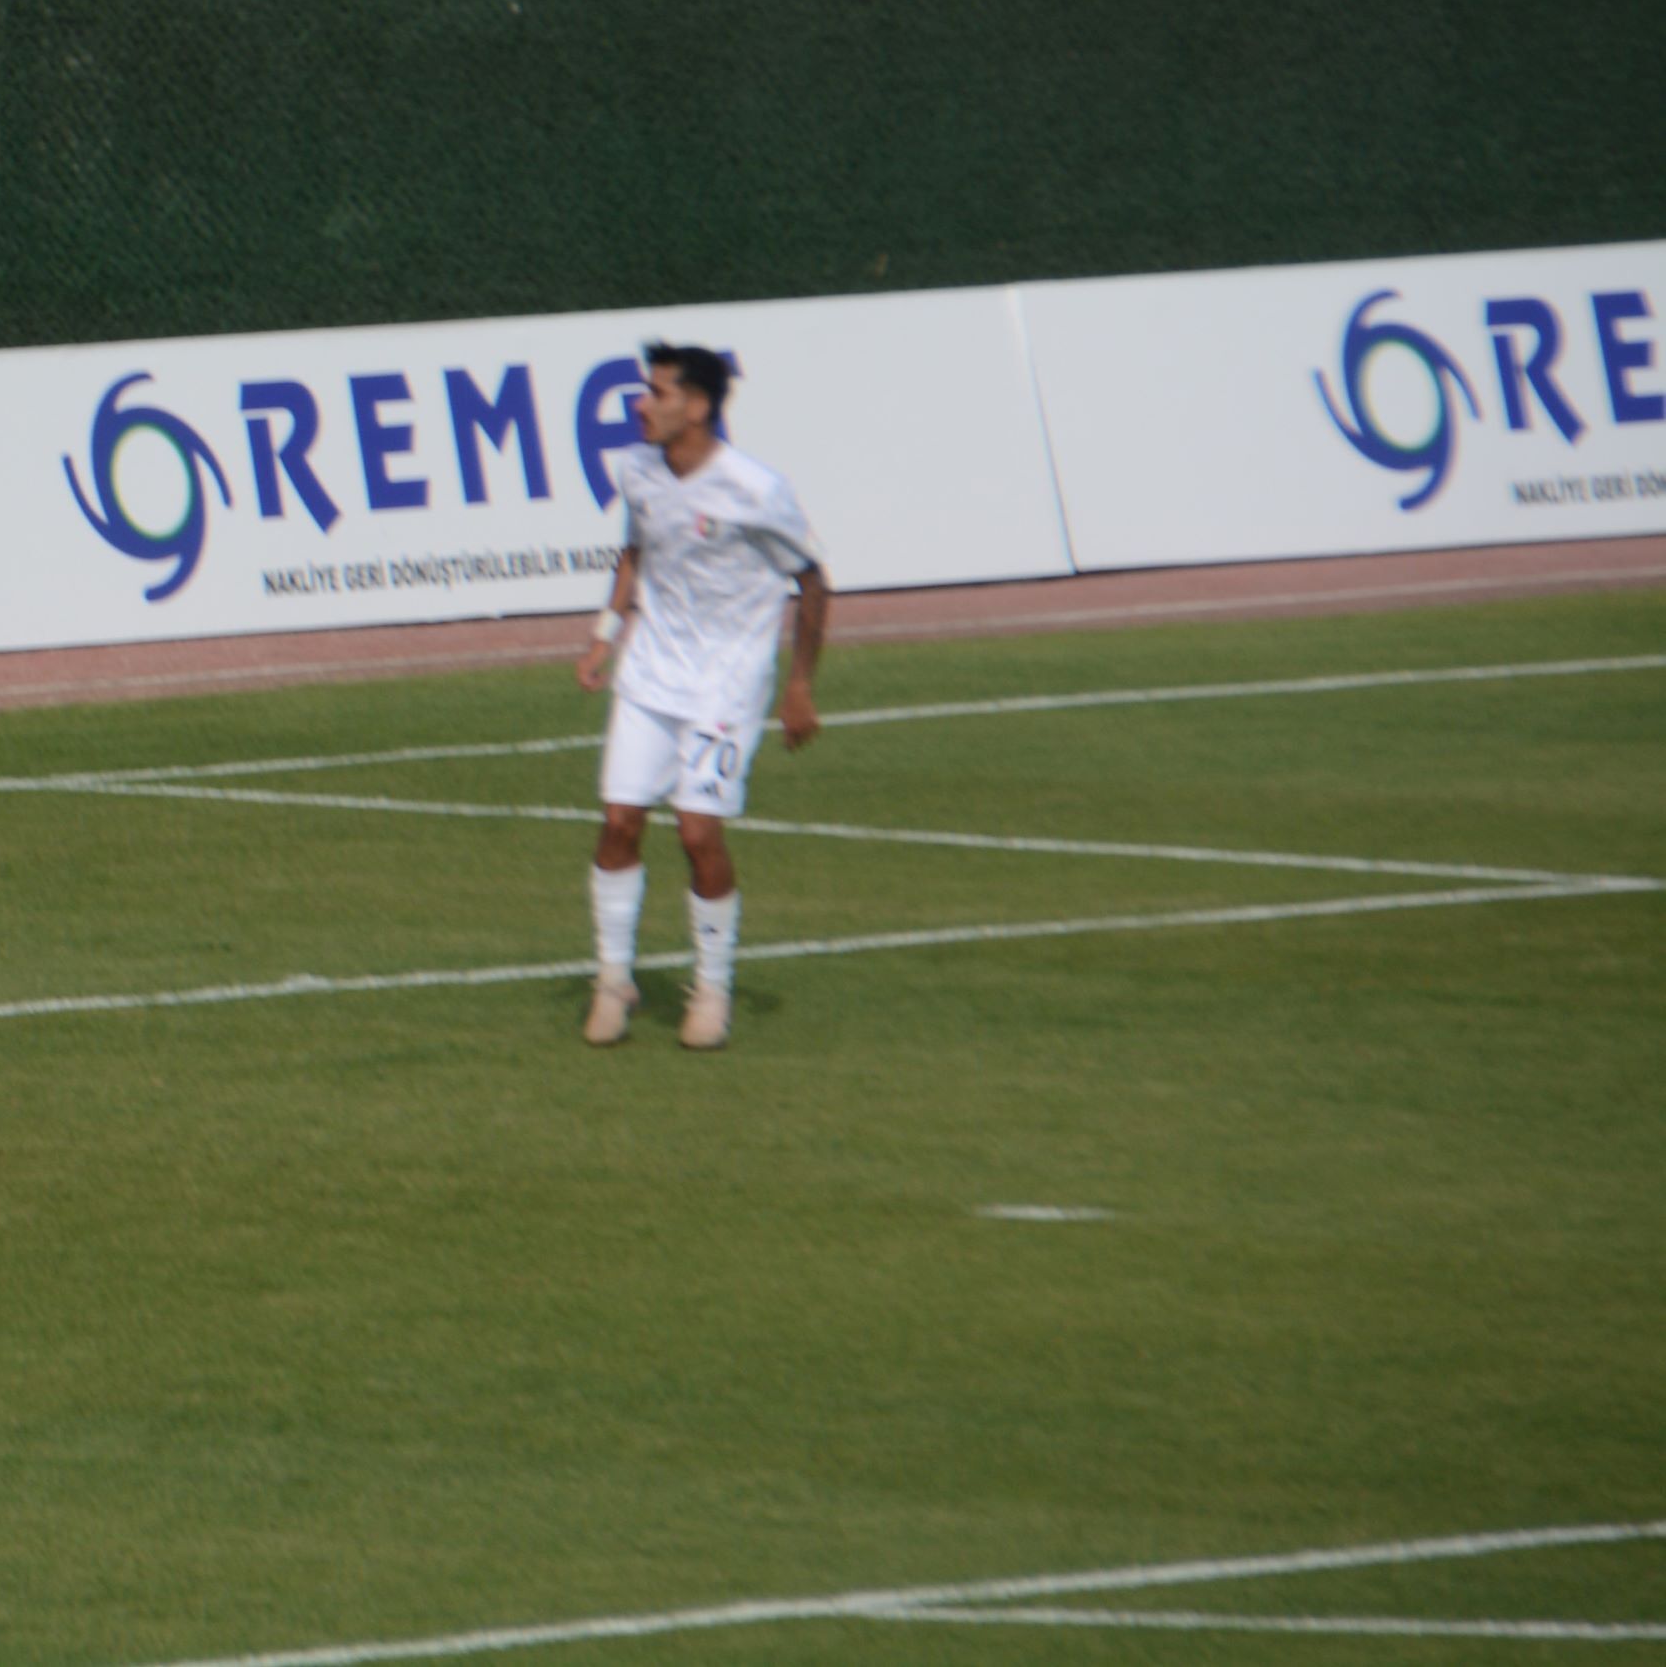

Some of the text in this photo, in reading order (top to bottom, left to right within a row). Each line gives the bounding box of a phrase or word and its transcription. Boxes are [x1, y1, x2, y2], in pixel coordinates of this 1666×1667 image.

[240, 349, 743, 534] REMA
[263, 559, 339, 597] NAKLİYE
[343, 553, 386, 591] GERİ
[688, 731, 742, 780] 70
